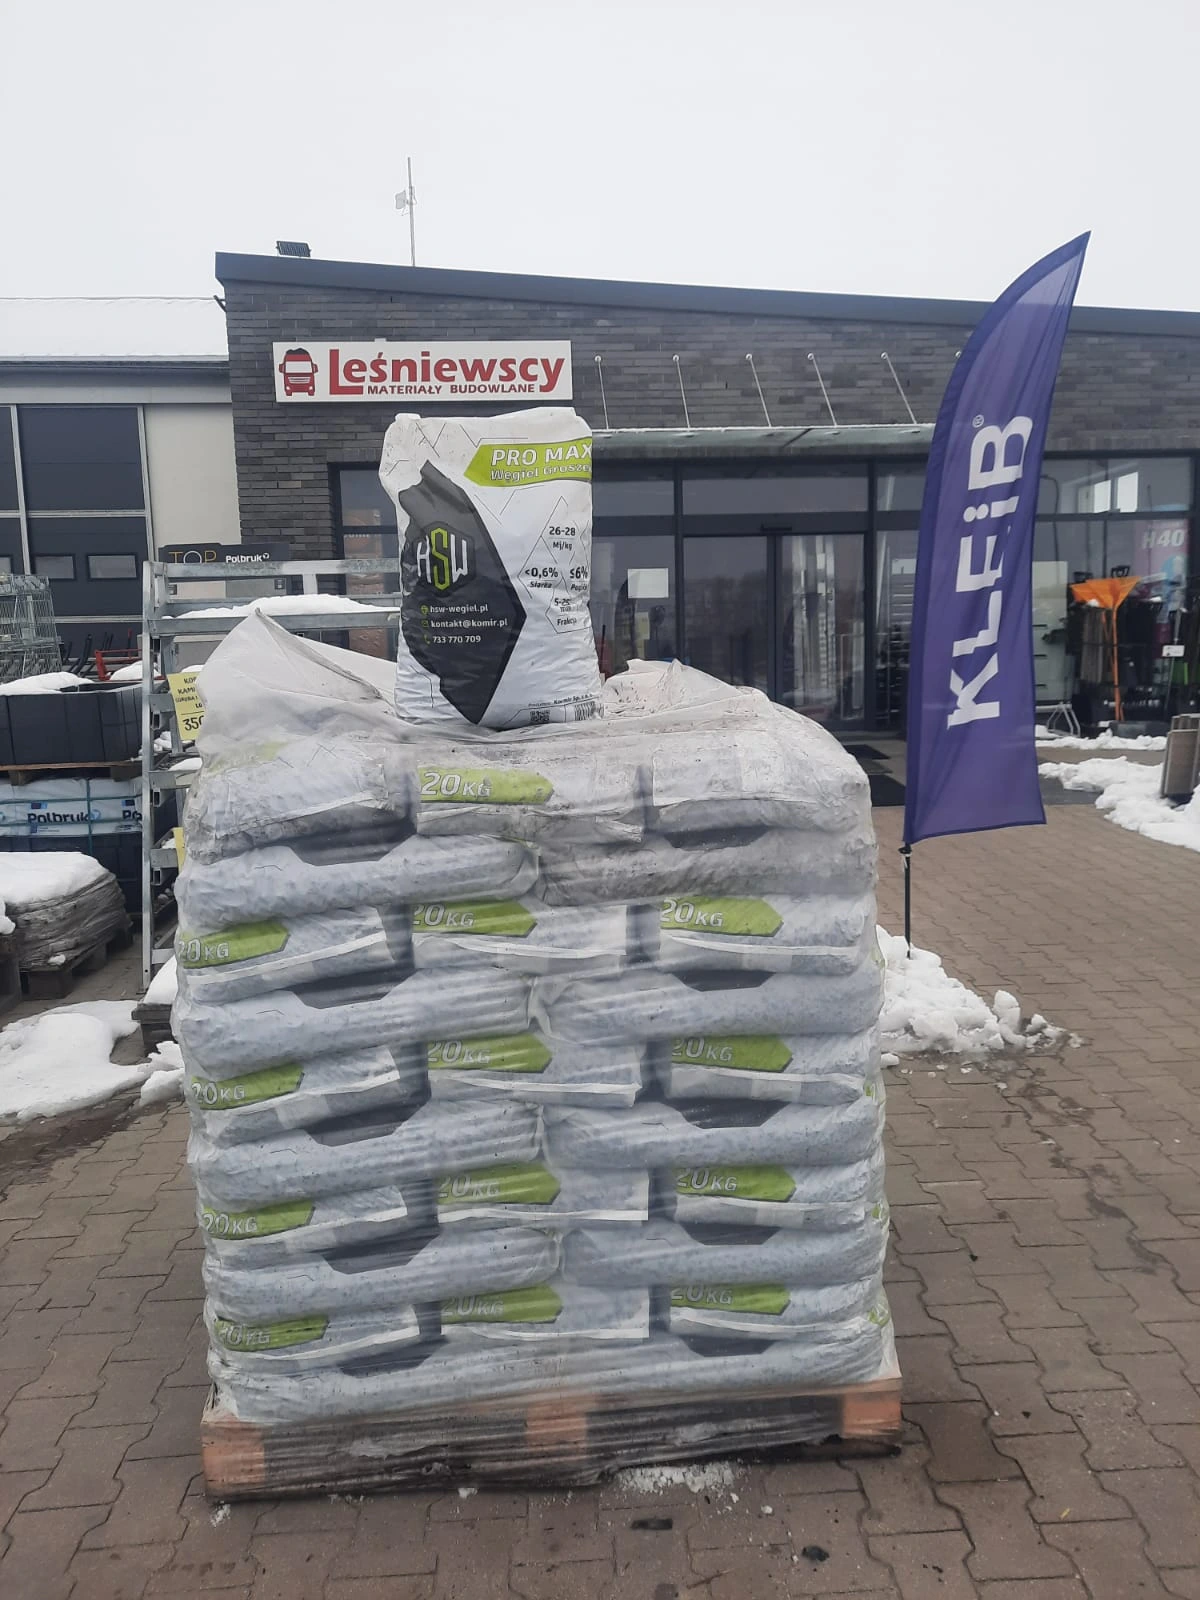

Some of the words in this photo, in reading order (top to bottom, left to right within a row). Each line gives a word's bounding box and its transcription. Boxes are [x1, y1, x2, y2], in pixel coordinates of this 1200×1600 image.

[329, 348, 565, 395] Leśniewscy
[367, 384, 442, 395] MATERIAŁY
[449, 383, 535, 394] BUDOWLANE
[491, 448, 538, 466] PRO
[544, 443, 593, 463] MAX
[543, 463, 592, 475] Grosze
[549, 526, 576, 536] 26-28
[225, 553, 263, 563] Polbruk
[416, 527, 469, 590] HSW
[525, 567, 559, 579] <0,6%
[430, 617, 509, 629] kontakt@komir.pl
[432, 635, 447, 644] 733
[448, 635, 463, 643] 770
[465, 635, 482, 643] 709
